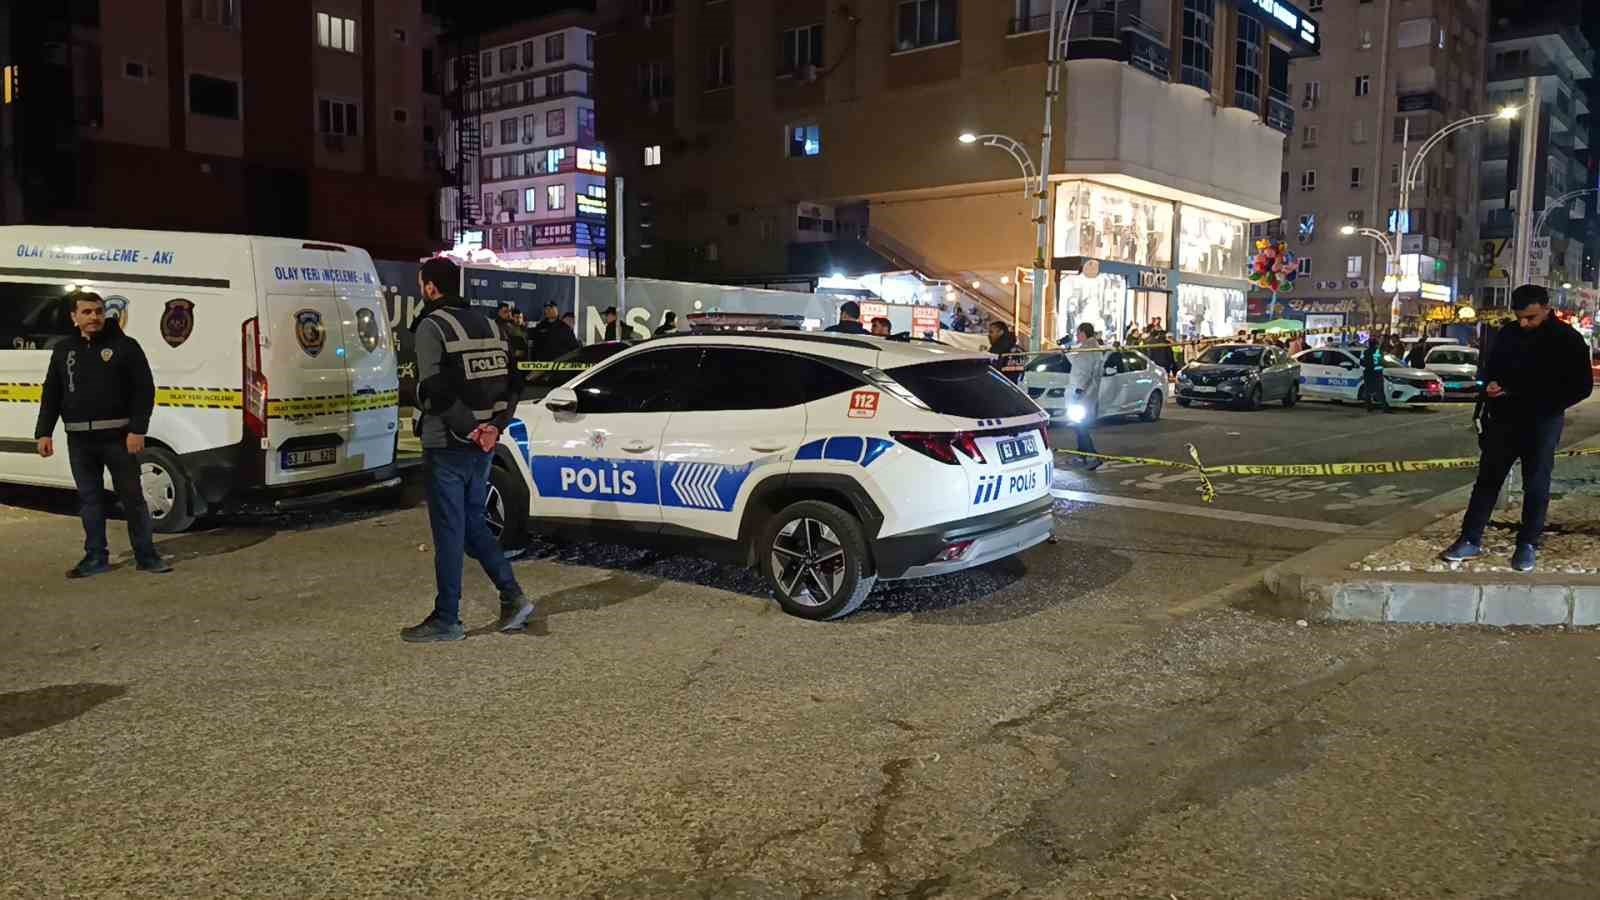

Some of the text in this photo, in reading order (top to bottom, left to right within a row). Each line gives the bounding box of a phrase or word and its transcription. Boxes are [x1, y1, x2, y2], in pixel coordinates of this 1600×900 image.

[274, 266, 298, 280] OLAY
[854, 394, 876, 409] 112
[560, 462, 638, 496] POLİS
